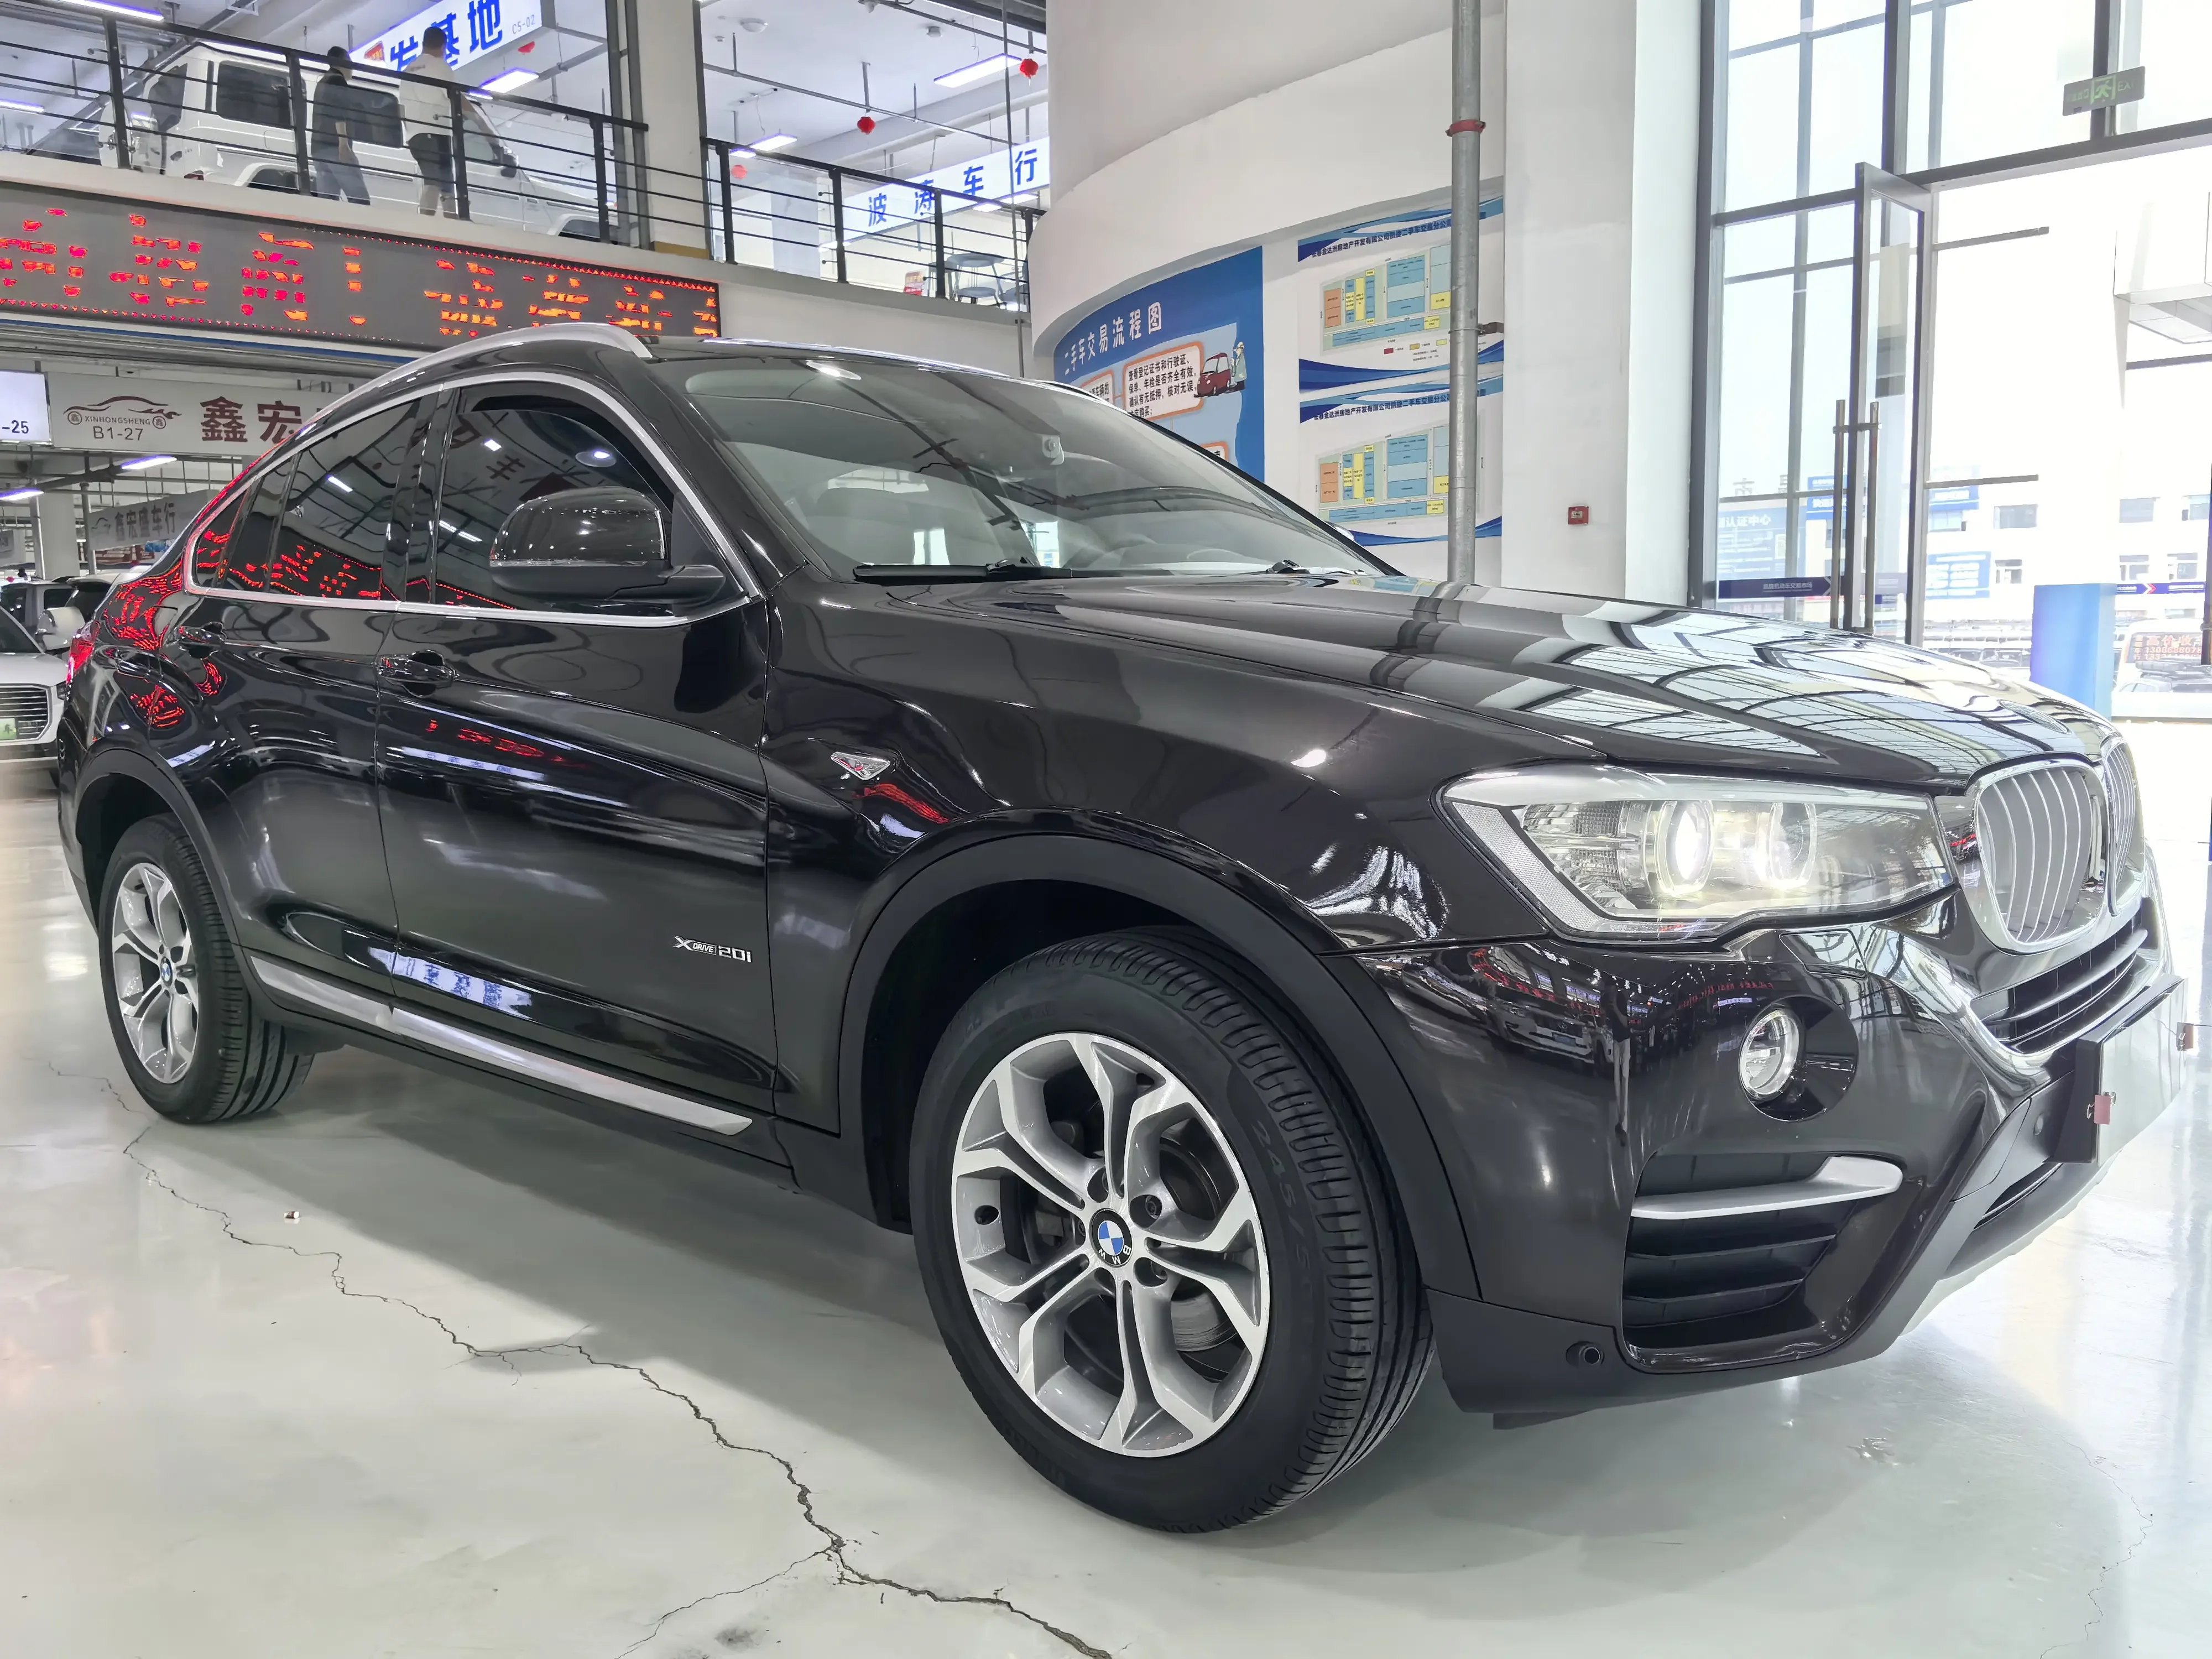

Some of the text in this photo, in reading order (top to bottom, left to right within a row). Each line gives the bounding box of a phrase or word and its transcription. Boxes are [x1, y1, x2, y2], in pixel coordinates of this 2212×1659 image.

[512, 14, 536, 34] C5-02
[1065, 302, 1161, 375] 二手车交易流程图
[84, 415, 150, 425] XINHONGSHENG
[200, 396, 322, 444] 鑫宏
[1130, 406, 1152, 418] 定购买；
[92, 426, 144, 441] B1-27
[1098, 1244, 1131, 1265] BMW
